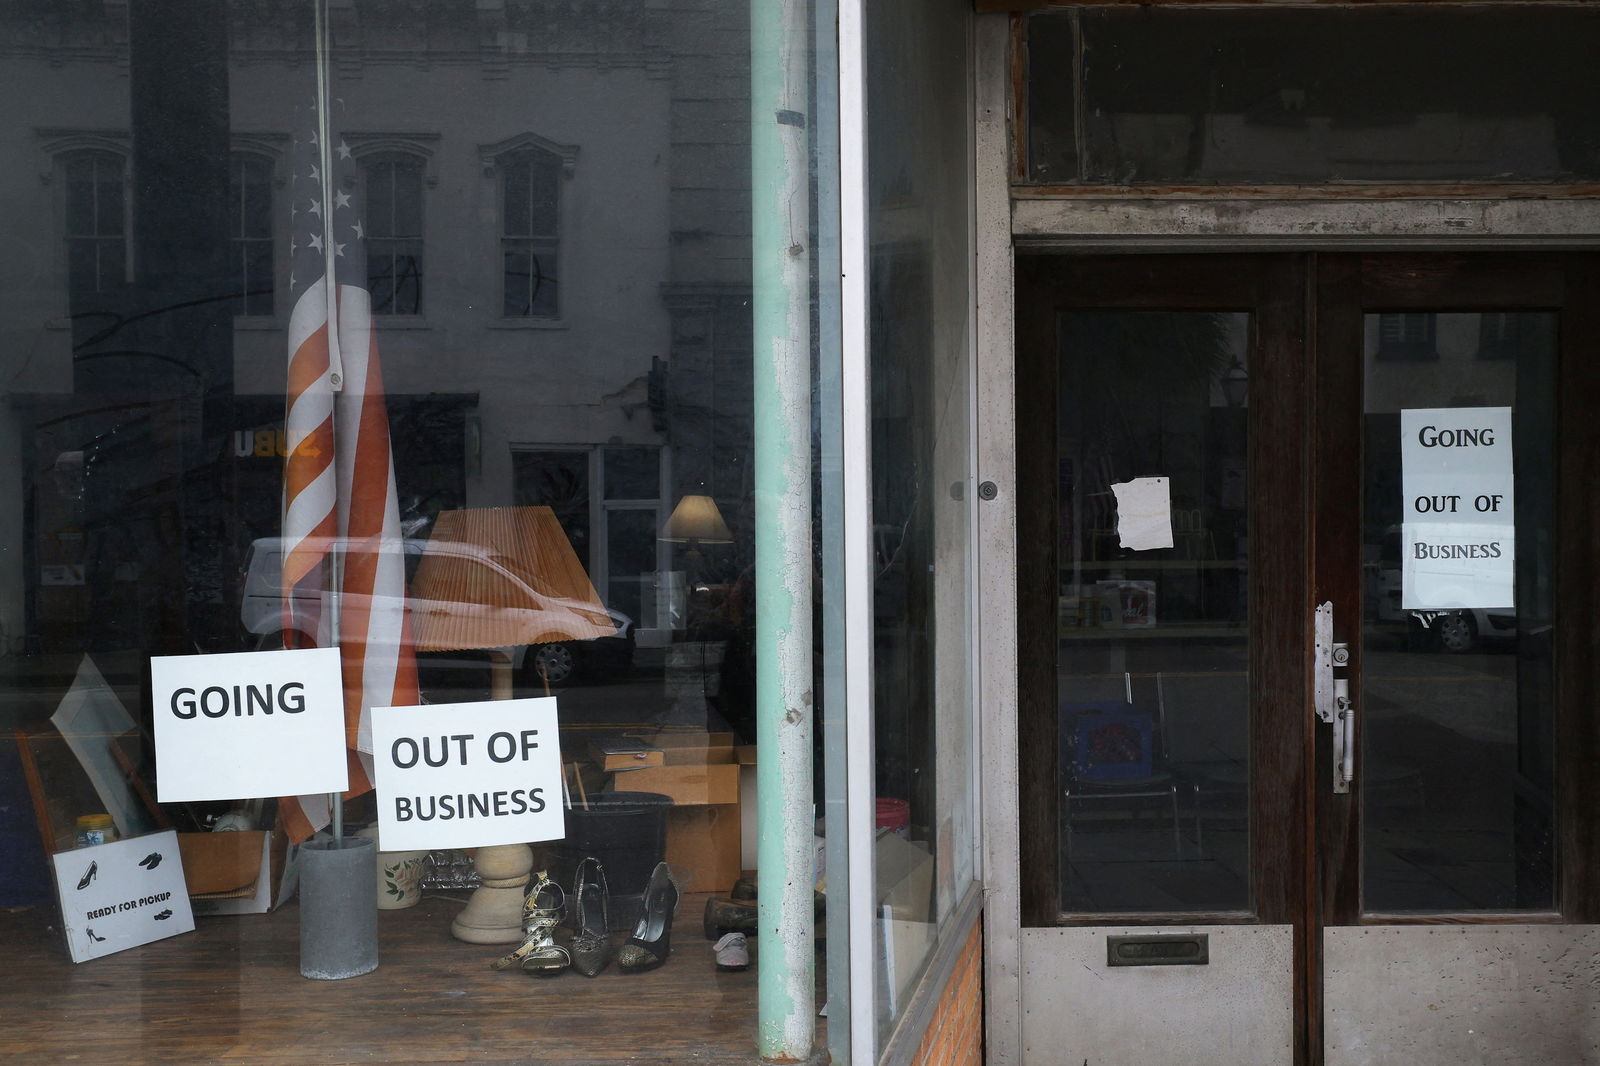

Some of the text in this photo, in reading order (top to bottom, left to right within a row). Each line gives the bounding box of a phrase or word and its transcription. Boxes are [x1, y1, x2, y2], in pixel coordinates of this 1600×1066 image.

[1418, 425, 1495, 448] GOING
[1414, 494, 1503, 513] OUT OF
[1414, 541, 1502, 560] BUSINESS
[170, 681, 306, 720] GOING
[391, 729, 539, 769] OUT OF
[395, 787, 546, 822] BUSINESS
[86, 891, 171, 920] READY FOR PICKUP
